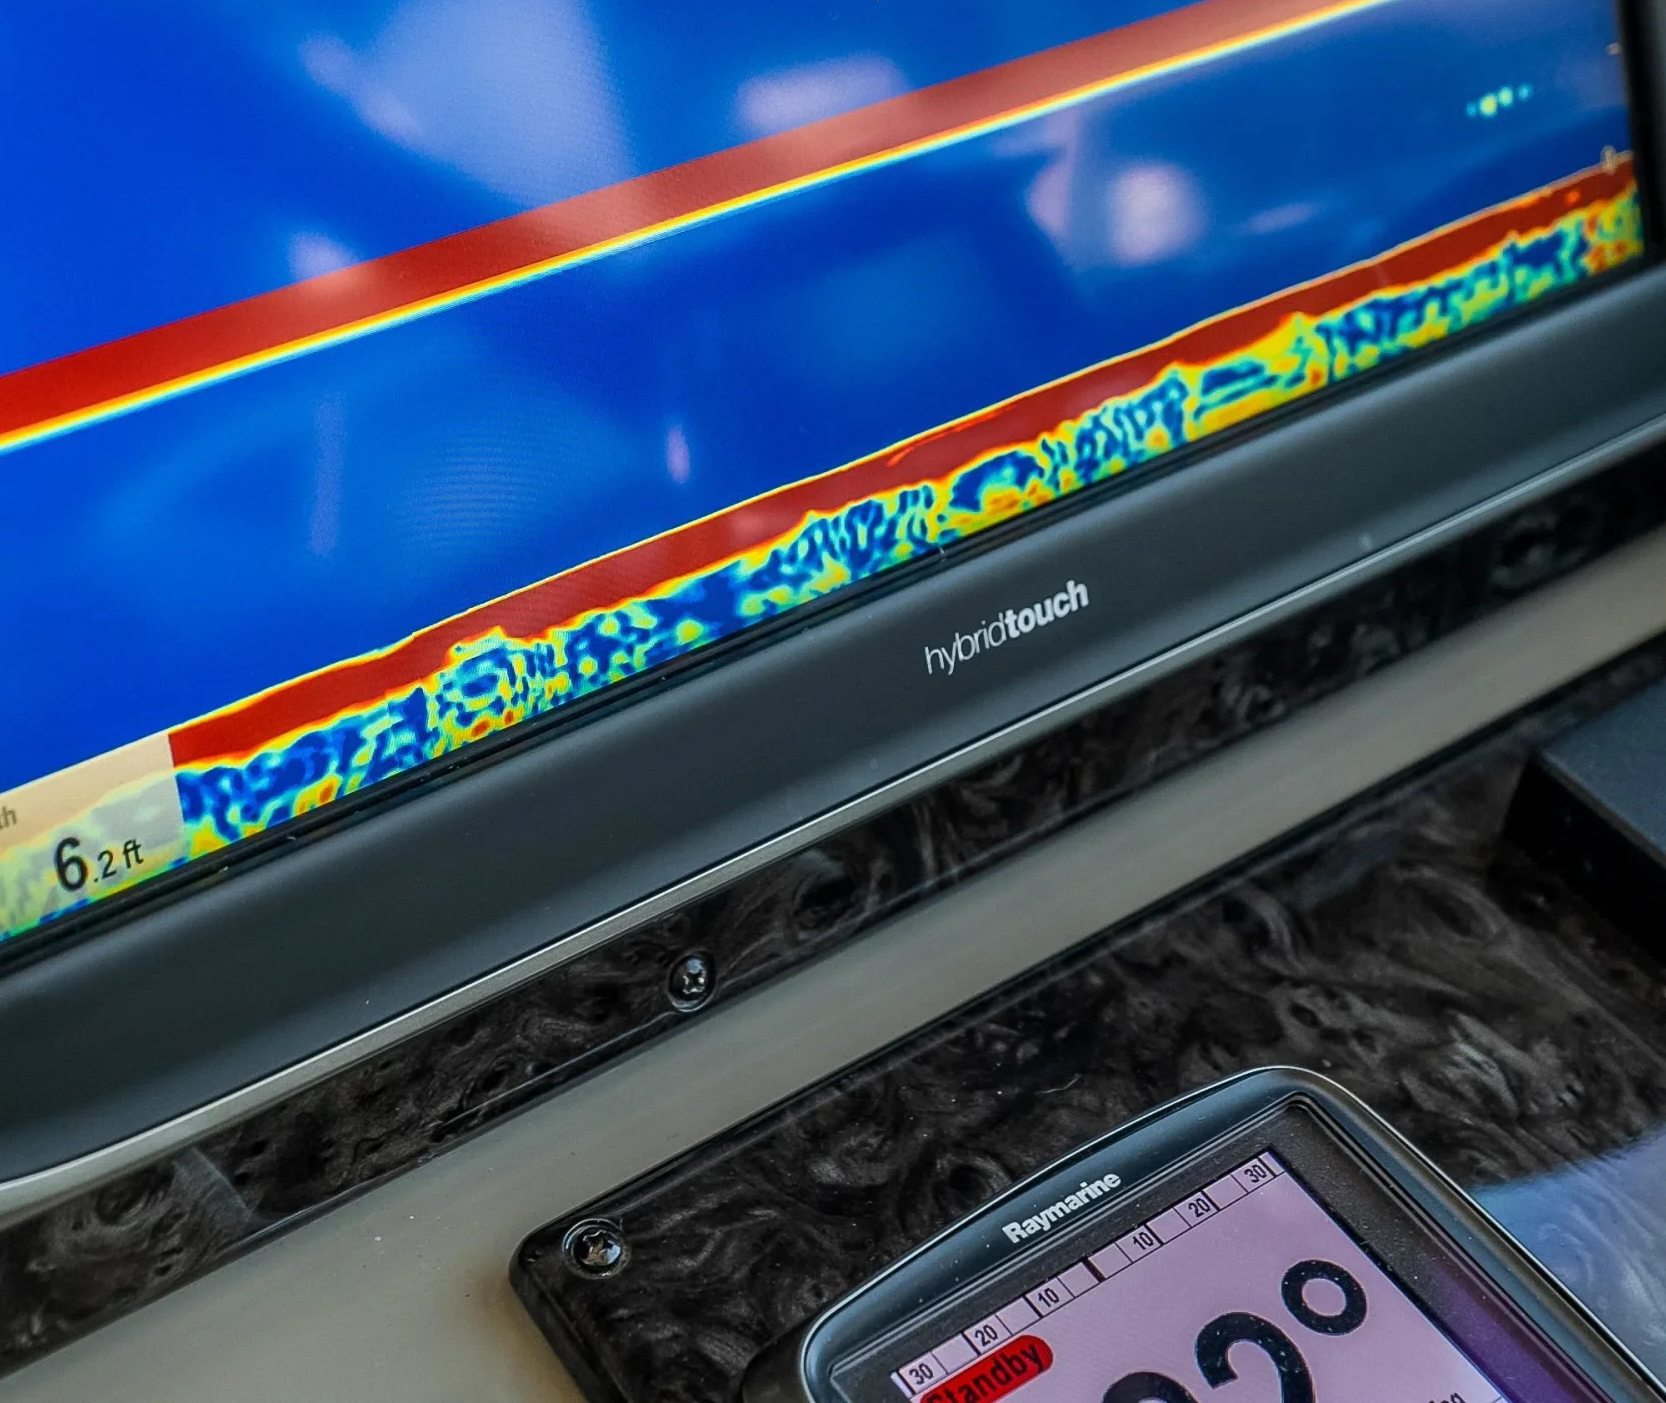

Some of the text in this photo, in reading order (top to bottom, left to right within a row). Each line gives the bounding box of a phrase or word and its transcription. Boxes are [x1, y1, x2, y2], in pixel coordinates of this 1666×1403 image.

[925, 580, 1089, 675] hybridtouch
[54, 837, 144, 892] 6.2 ft
[1002, 1172, 1121, 1244] Raymarine
[908, 1163, 1268, 1386] 30 20 10 10 20 30
